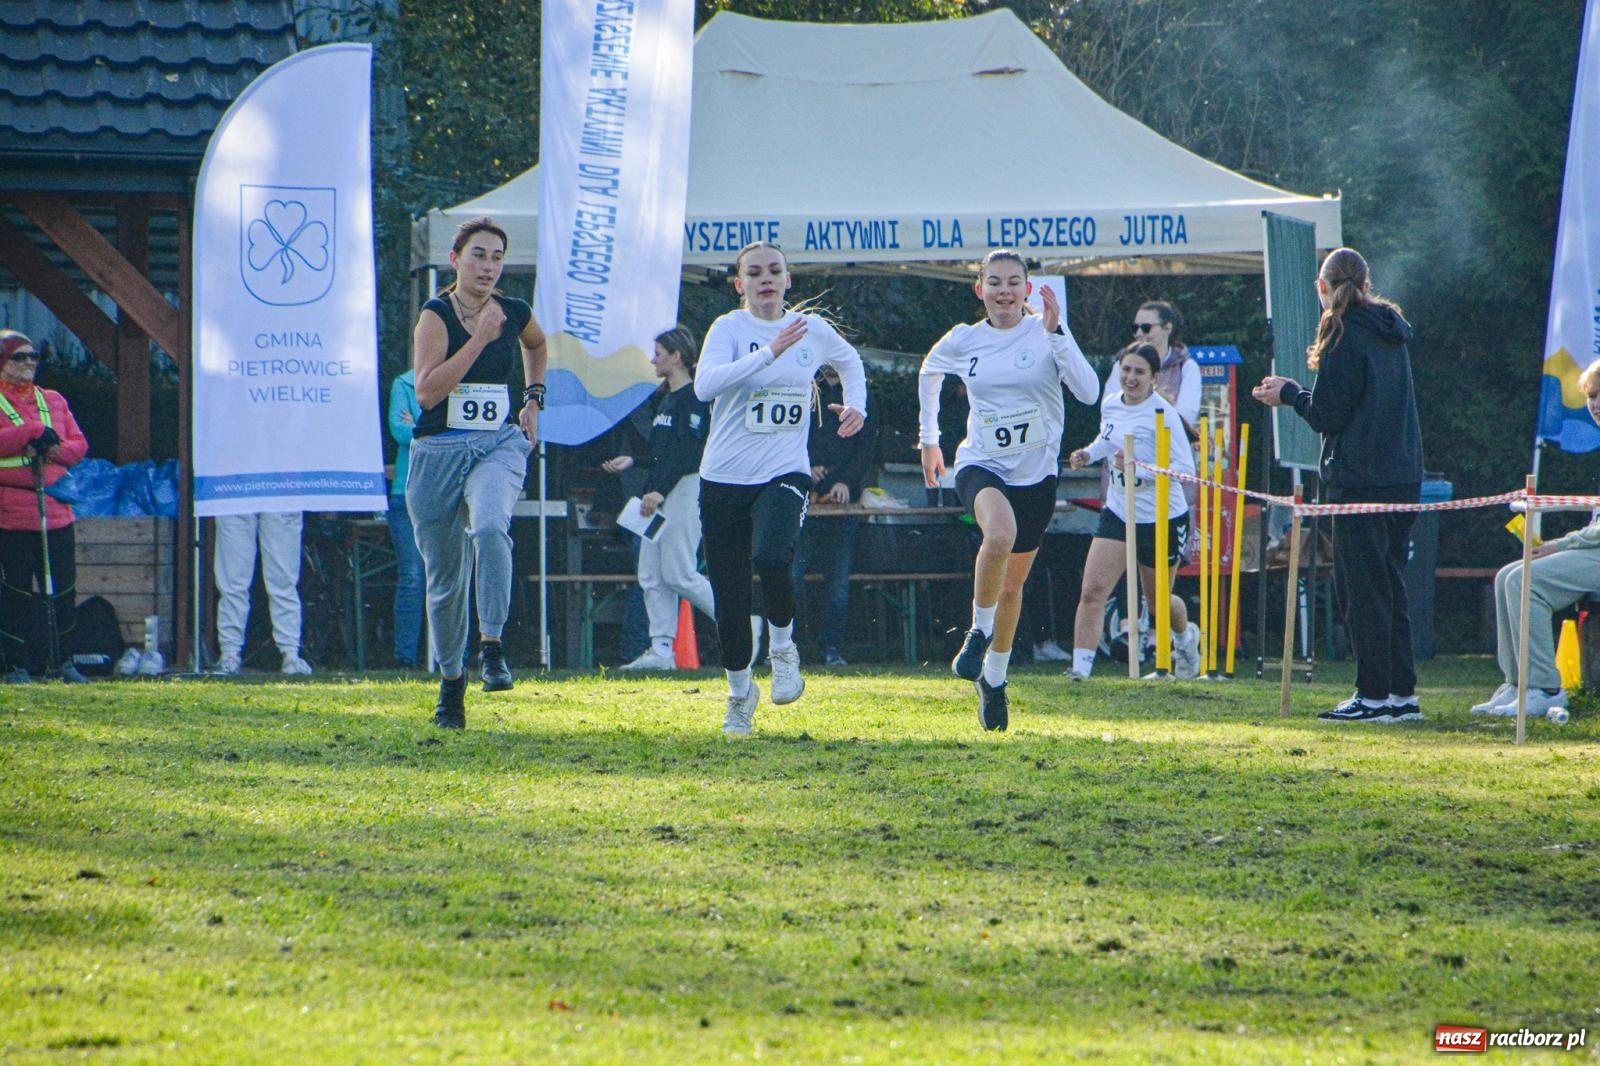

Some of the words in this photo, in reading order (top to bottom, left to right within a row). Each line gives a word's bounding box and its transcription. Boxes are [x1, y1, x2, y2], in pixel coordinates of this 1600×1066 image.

[804, 219, 900, 250] AKTYWNI
[922, 218, 964, 249] DLA
[986, 216, 1097, 247] LEPSZEGO
[1119, 214, 1188, 246] JUTRA
[254, 332, 323, 349] GMINA
[227, 359, 353, 377] PIETROWICE
[968, 356, 979, 377] 2
[248, 386, 332, 403] WIELKIE
[462, 400, 498, 421] 98
[751, 402, 803, 425] 109
[994, 422, 1030, 448] 97
[213, 478, 375, 493] www.pietrowicewielkie.com.pl
